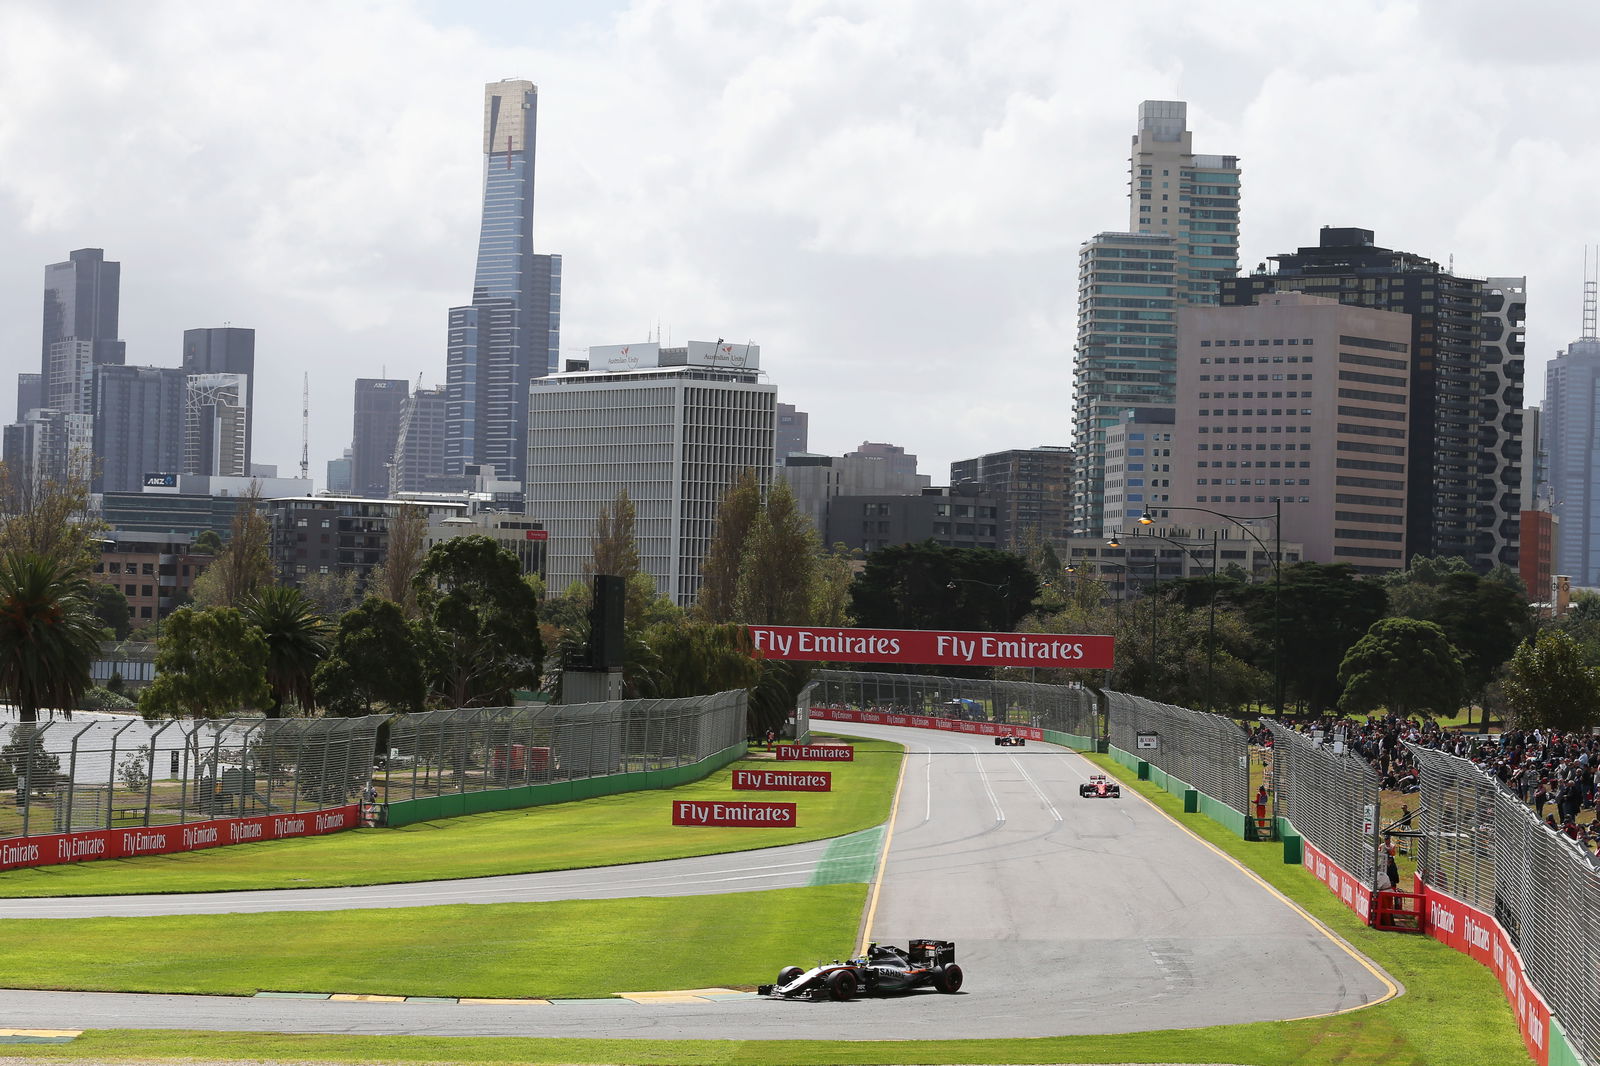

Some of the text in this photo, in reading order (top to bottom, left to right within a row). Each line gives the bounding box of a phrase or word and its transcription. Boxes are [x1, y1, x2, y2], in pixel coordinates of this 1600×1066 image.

[754, 630, 900, 656] Fly Emirates
[936, 635, 1084, 661] Fly Emirates
[781, 746, 850, 760] Fly Emirates
[738, 772, 826, 788] Fly Emirates
[316, 812, 344, 832] Fly Emirates
[680, 803, 790, 823] Fly Emirates
[183, 825, 218, 849] Fly Emirates
[230, 820, 262, 843] Fly Emirates
[275, 816, 305, 838] Fly Emirates
[1365, 824, 1372, 833] F
[3, 843, 39, 864] Emirates
[58, 835, 105, 861] Fly Emirates
[123, 831, 166, 855] Fly Emirates
